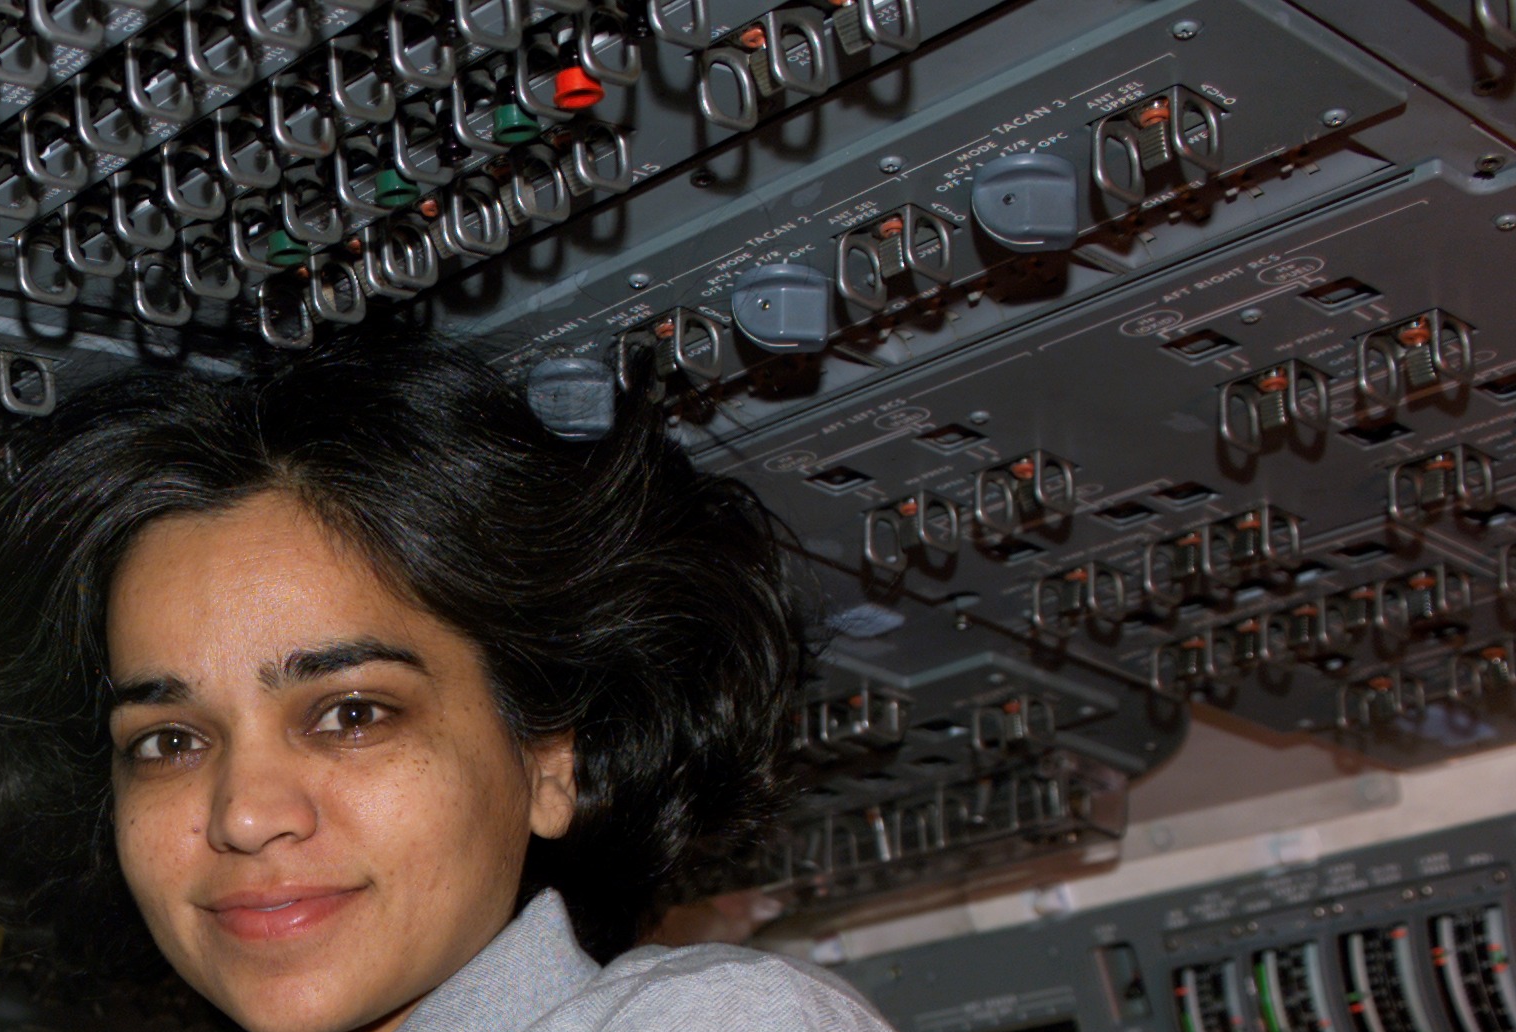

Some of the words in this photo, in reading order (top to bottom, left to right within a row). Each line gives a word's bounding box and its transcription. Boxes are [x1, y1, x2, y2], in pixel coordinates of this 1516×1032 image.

[1086, 92, 1117, 110] ANT
[1117, 80, 1145, 95] SEL
[1099, 90, 1146, 112] UPPER
[992, 106, 1053, 136] TACAN
[1003, 138, 1030, 155] T/R
[1037, 131, 1069, 148] GPC
[956, 140, 999, 163] MODE
[943, 163, 972, 180] RCV
[935, 178, 962, 193] OFF
[827, 210, 854, 225] ANT
[854, 200, 879, 213] SEL
[840, 208, 882, 228] UPPER
[745, 222, 798, 247] TACAN
[788, 244, 817, 259] GPC
[716, 252, 754, 271] MODE
[706, 271, 733, 286] RCV
[1161, 287, 1192, 303] AFT
[1193, 267, 1245, 290] RIGHT
[1247, 253, 1282, 270] RCS
[701, 284, 724, 298] OFF
[606, 312, 629, 326] ANT
[618, 309, 654, 327] UPPER
[533, 321, 579, 343] TACAN
[821, 421, 846, 435] AFT
[847, 409, 877, 424] LEFT
